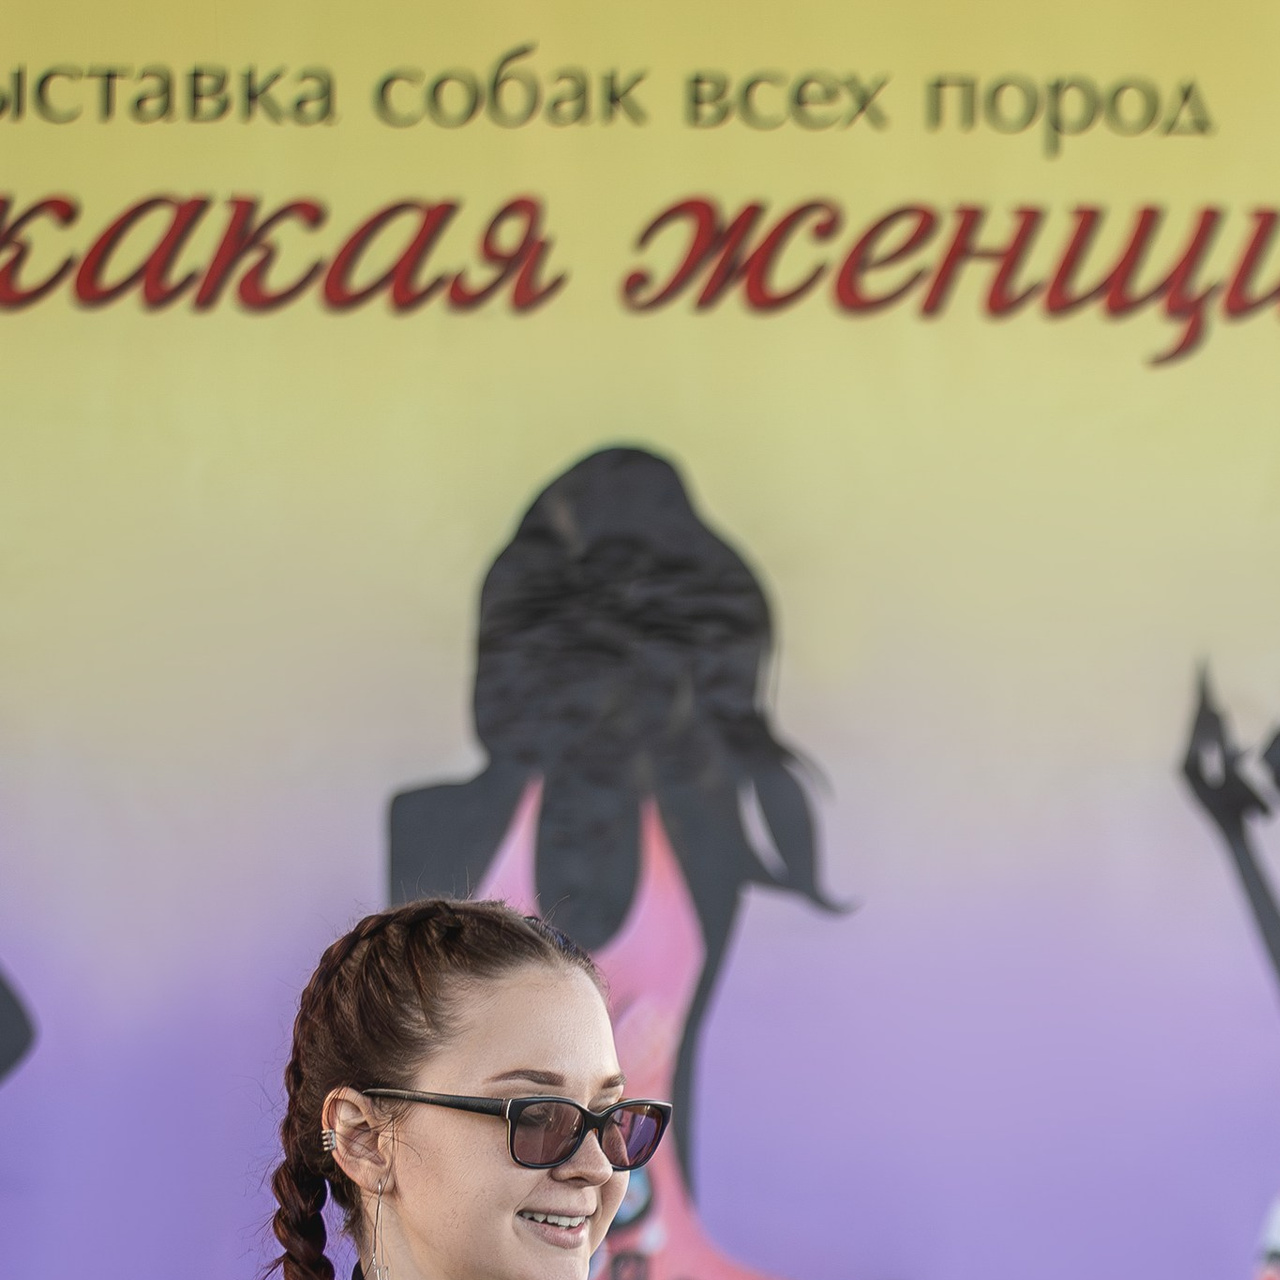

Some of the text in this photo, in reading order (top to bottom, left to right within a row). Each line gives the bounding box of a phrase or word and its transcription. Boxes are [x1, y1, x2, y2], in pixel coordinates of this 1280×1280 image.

[371, 42, 650, 129] собак
[684, 66, 893, 132] всех
[924, 72, 1218, 158] пород
[0, 190, 570, 315] какая
